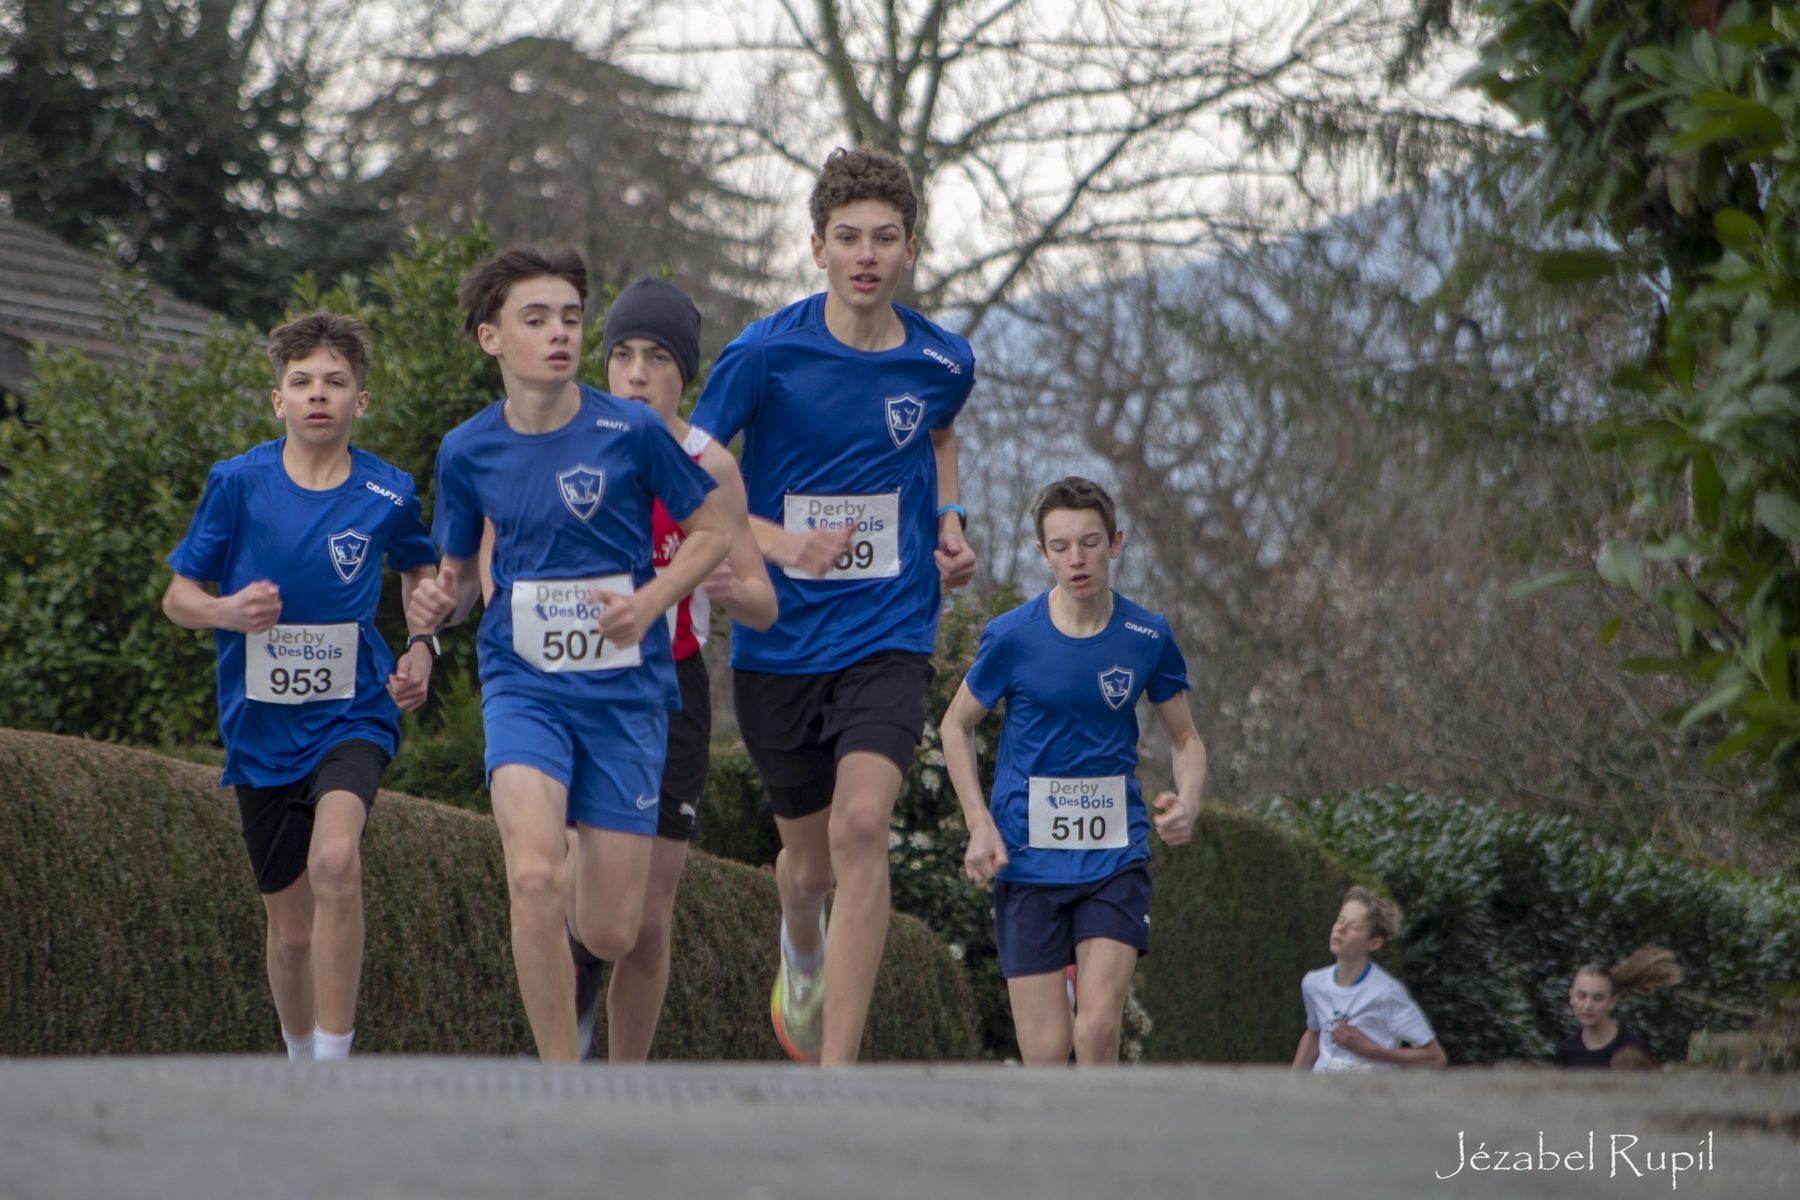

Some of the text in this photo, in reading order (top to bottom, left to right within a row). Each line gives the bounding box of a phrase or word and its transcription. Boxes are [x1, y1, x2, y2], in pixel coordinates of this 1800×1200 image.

[923, 348, 955, 369] CRAFT
[365, 481, 397, 501] CRAFT
[809, 499, 866, 520] Derby
[268, 627, 326, 648] Derby
[1124, 621, 1153, 636] CRAFT
[278, 645, 343, 661] DesBois
[542, 629, 606, 662] 507
[270, 667, 332, 696] 953
[1049, 780, 1099, 798] Derby
[1059, 795, 1114, 810] DesBois
[1051, 816, 1106, 841] 510
